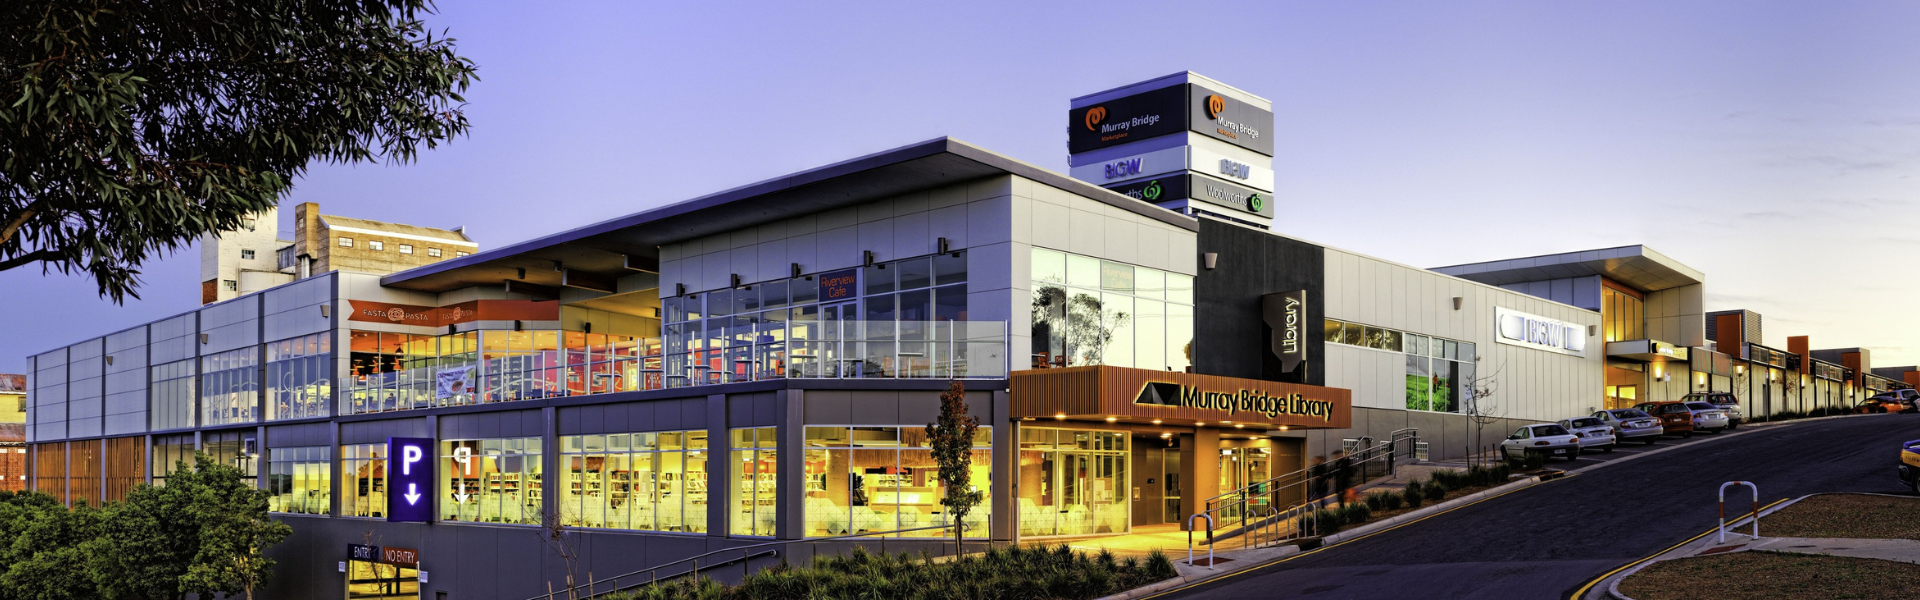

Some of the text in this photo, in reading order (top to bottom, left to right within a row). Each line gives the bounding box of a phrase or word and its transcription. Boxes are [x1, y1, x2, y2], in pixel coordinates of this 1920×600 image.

[1101, 114, 1160, 134] Murray Bridge
[1216, 115, 1259, 139] Murray Bridge
[1206, 184, 1248, 206] Woolworths
[820, 275, 856, 288] Riverview
[828, 287, 847, 298] Cafe
[362, 308, 429, 321] FASTA PASTA
[1282, 296, 1300, 354] Library
[1182, 384, 1333, 422] Murray Bridge Library
[403, 445, 422, 475] P
[385, 549, 415, 564] NO ENTRY
